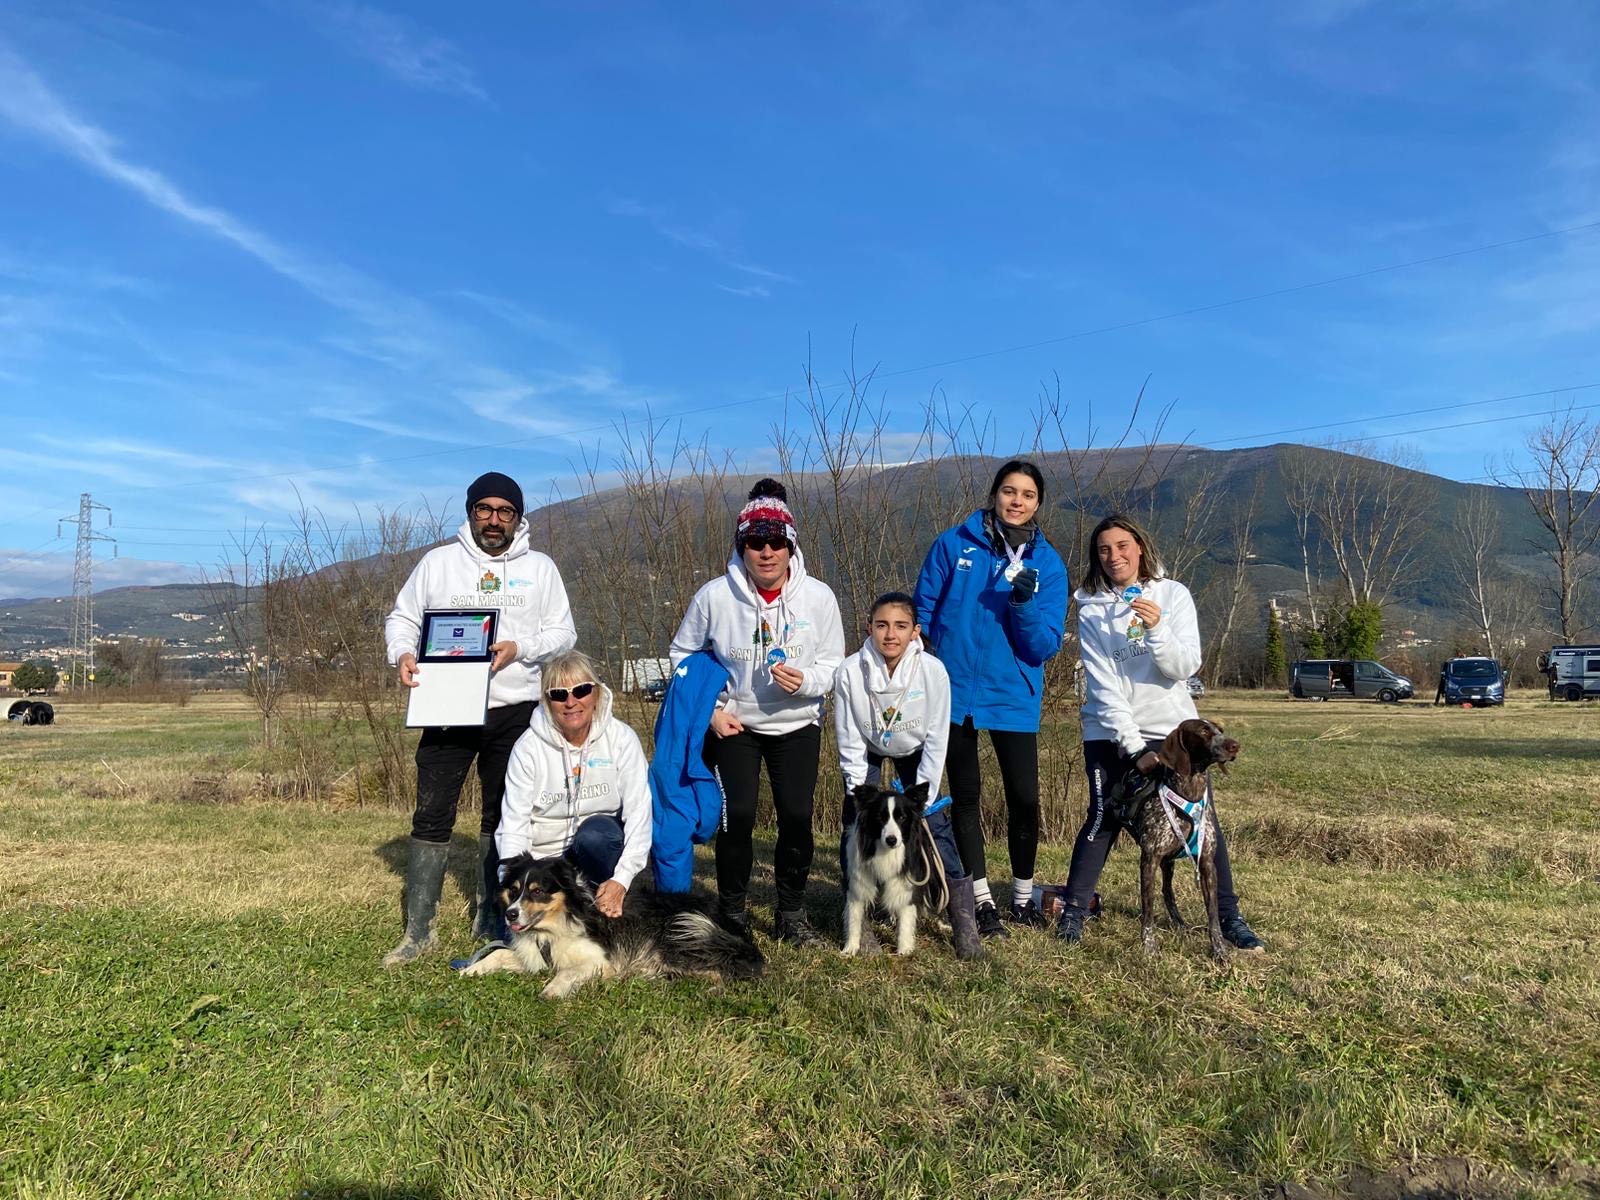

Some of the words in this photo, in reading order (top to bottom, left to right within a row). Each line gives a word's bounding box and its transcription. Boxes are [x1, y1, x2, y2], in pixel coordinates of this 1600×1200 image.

[451, 595, 475, 607] SAN
[479, 595, 526, 607] MARINO
[730, 647, 752, 661] SAN
[756, 645, 804, 662] MINO
[540, 790, 563, 805] SAN
[566, 782, 611, 805] RINO
